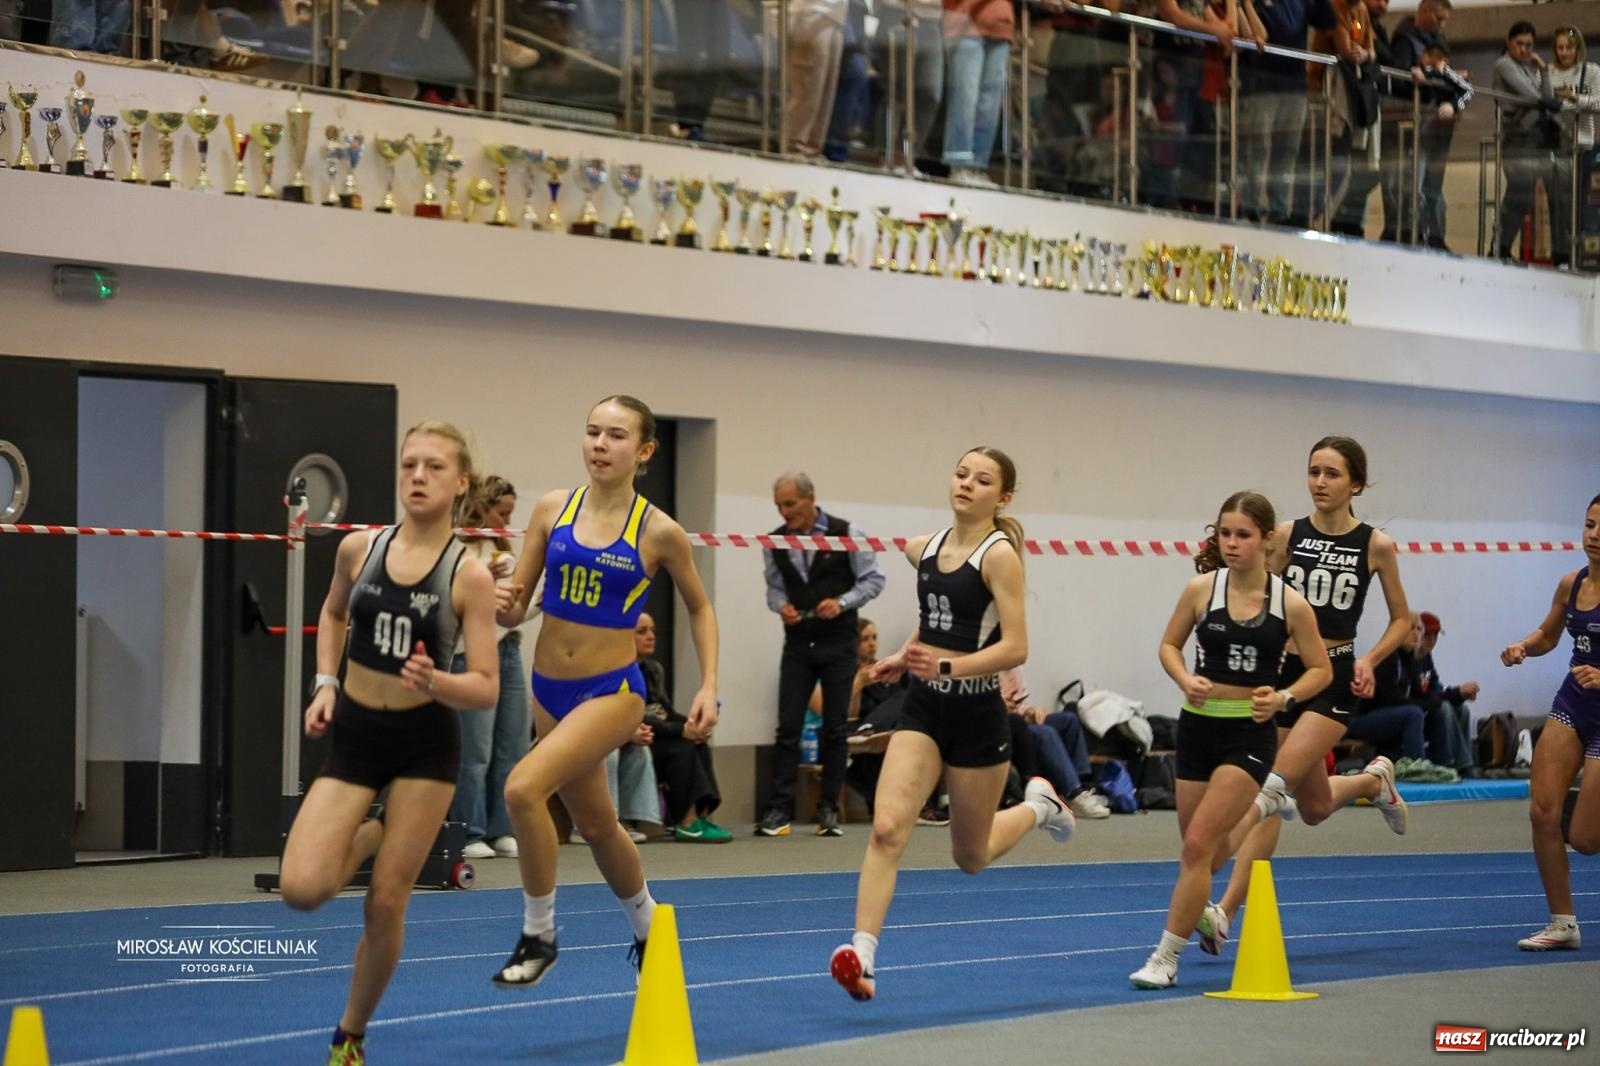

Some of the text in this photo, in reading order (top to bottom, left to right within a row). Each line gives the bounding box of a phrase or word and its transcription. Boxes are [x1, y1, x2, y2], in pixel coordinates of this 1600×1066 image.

[1296, 538, 1335, 552] JUST
[595, 556, 636, 572] KATOWICE
[1319, 551, 1359, 566] TEAM
[560, 563, 603, 607] 105
[1286, 565, 1359, 610] 306
[374, 611, 412, 659] 40
[1227, 643, 1258, 672] 53
[958, 672, 999, 695] NIKE
